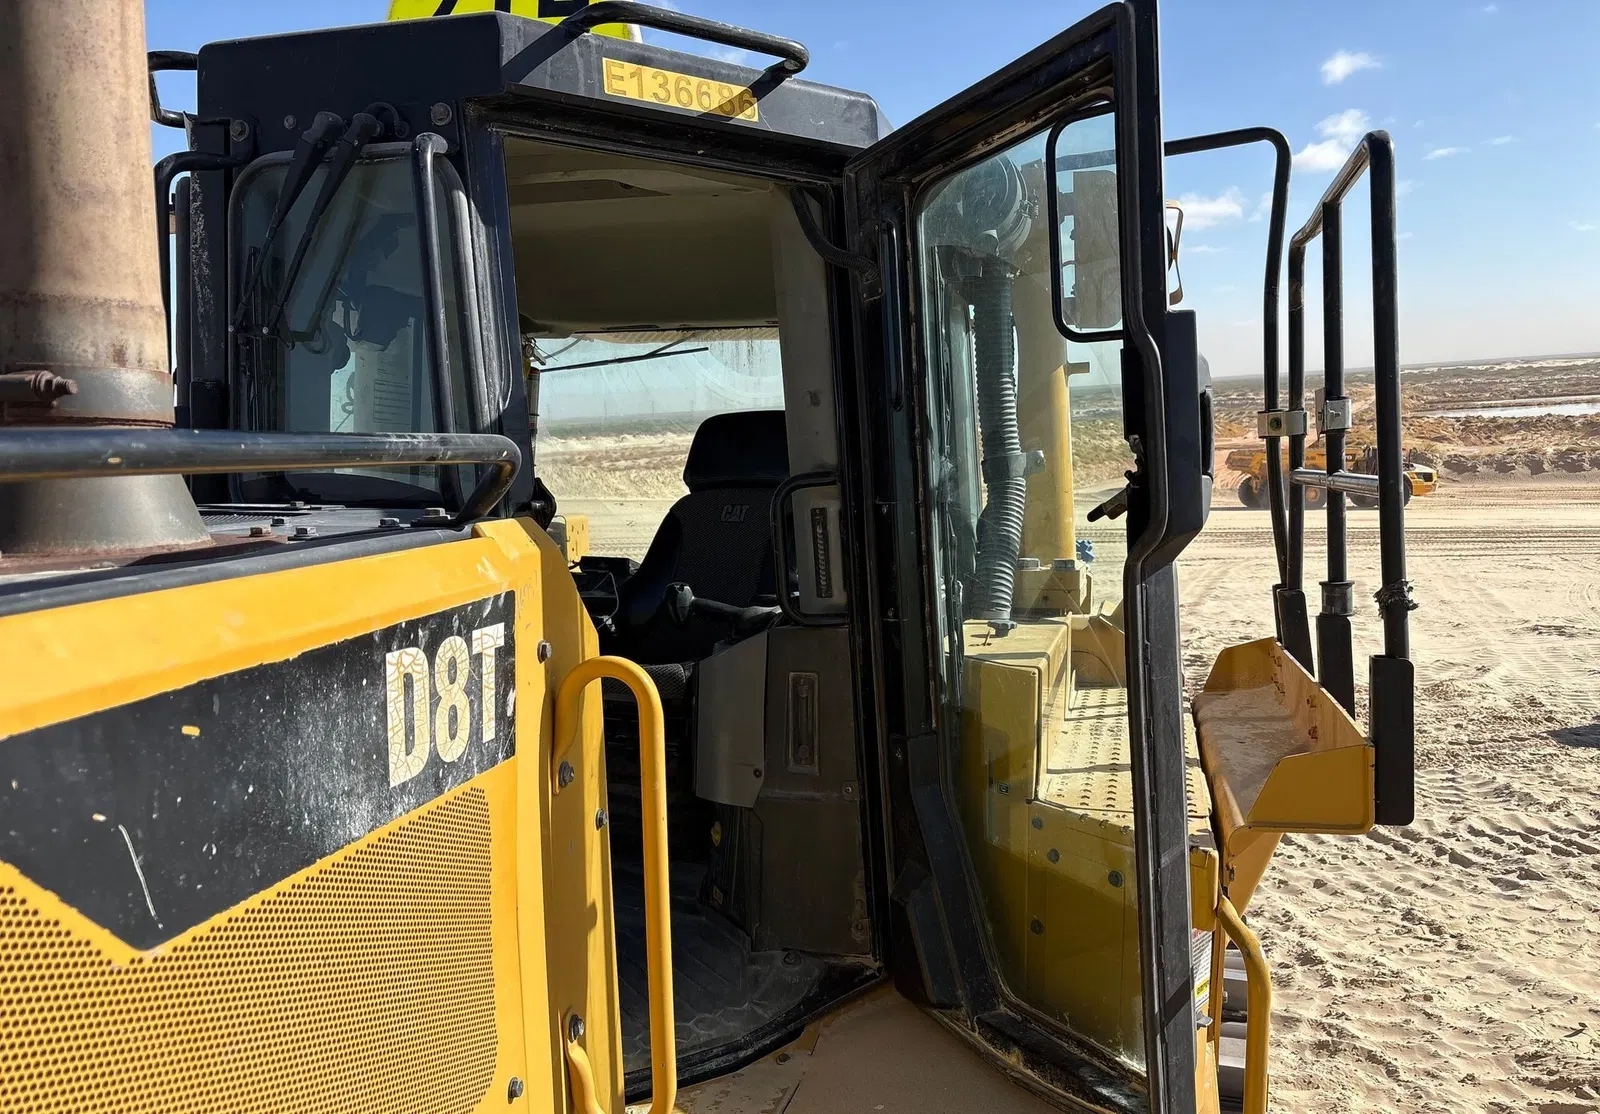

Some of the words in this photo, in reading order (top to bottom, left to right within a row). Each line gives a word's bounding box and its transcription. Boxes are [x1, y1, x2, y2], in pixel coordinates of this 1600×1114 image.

[604, 59, 756, 120] E136686
[720, 504, 750, 522] CAT
[385, 622, 505, 788] D8T
